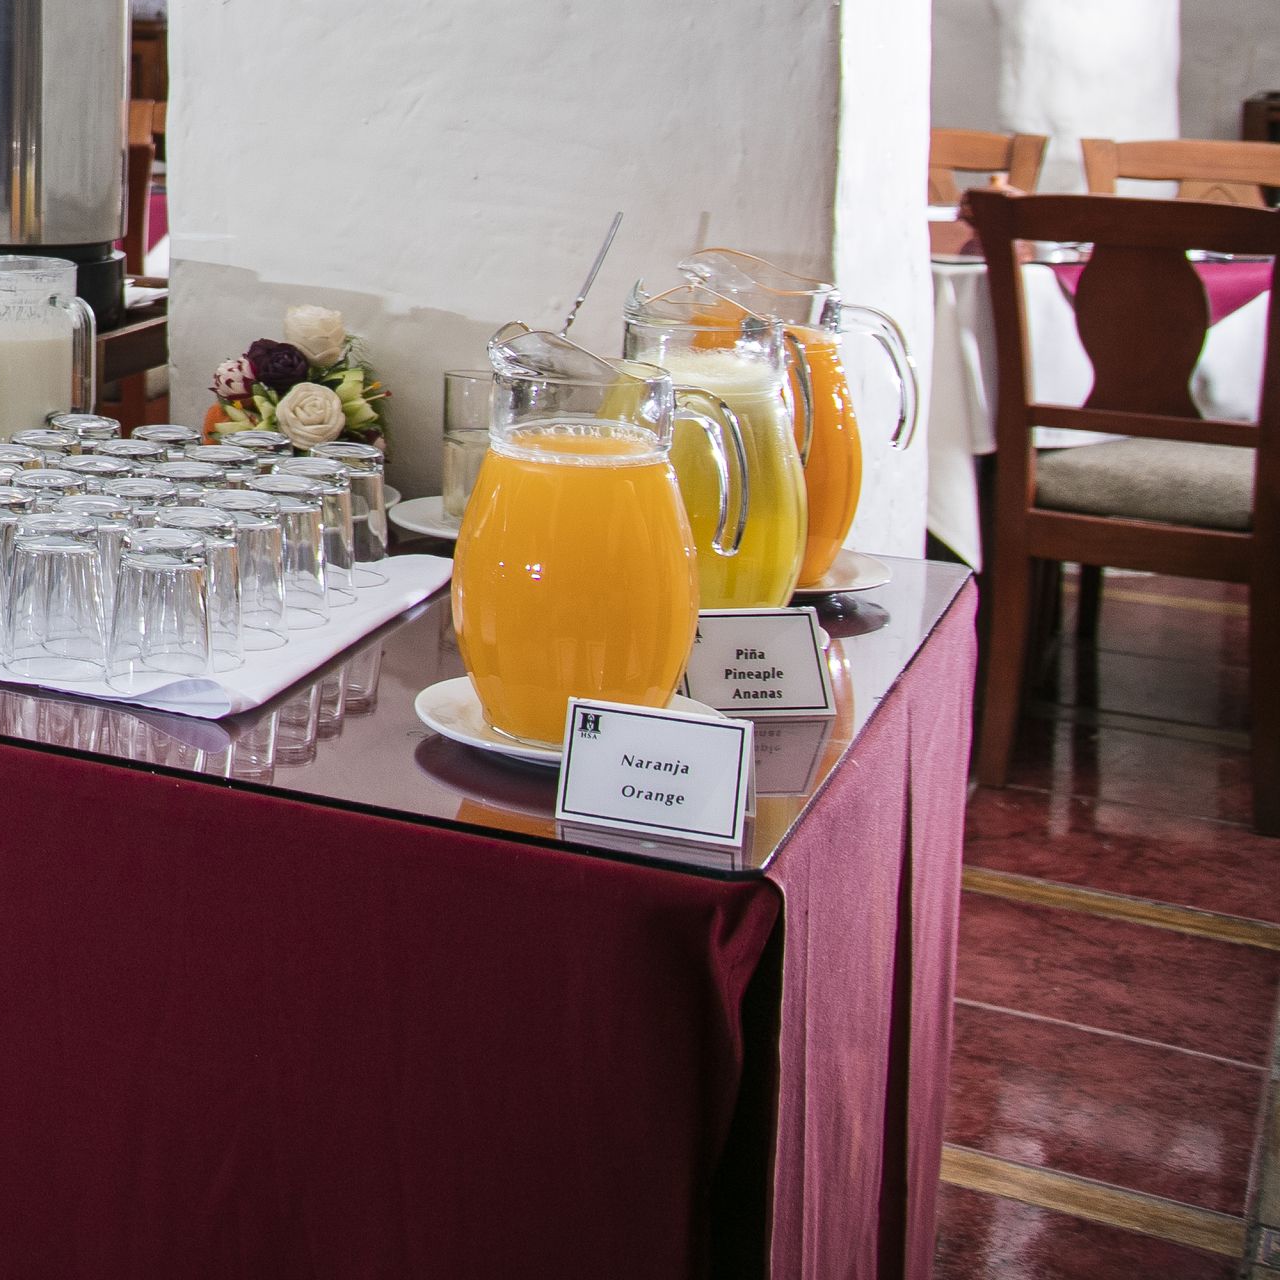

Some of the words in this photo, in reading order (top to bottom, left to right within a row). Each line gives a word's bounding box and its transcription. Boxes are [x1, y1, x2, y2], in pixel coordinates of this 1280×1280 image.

[735, 648, 766, 660] Piña
[724, 667, 784, 682] Pineaple
[732, 688, 783, 699] Ananas
[580, 731, 598, 740] HSA
[621, 754, 690, 776] Naranja
[621, 784, 685, 807] Orange
